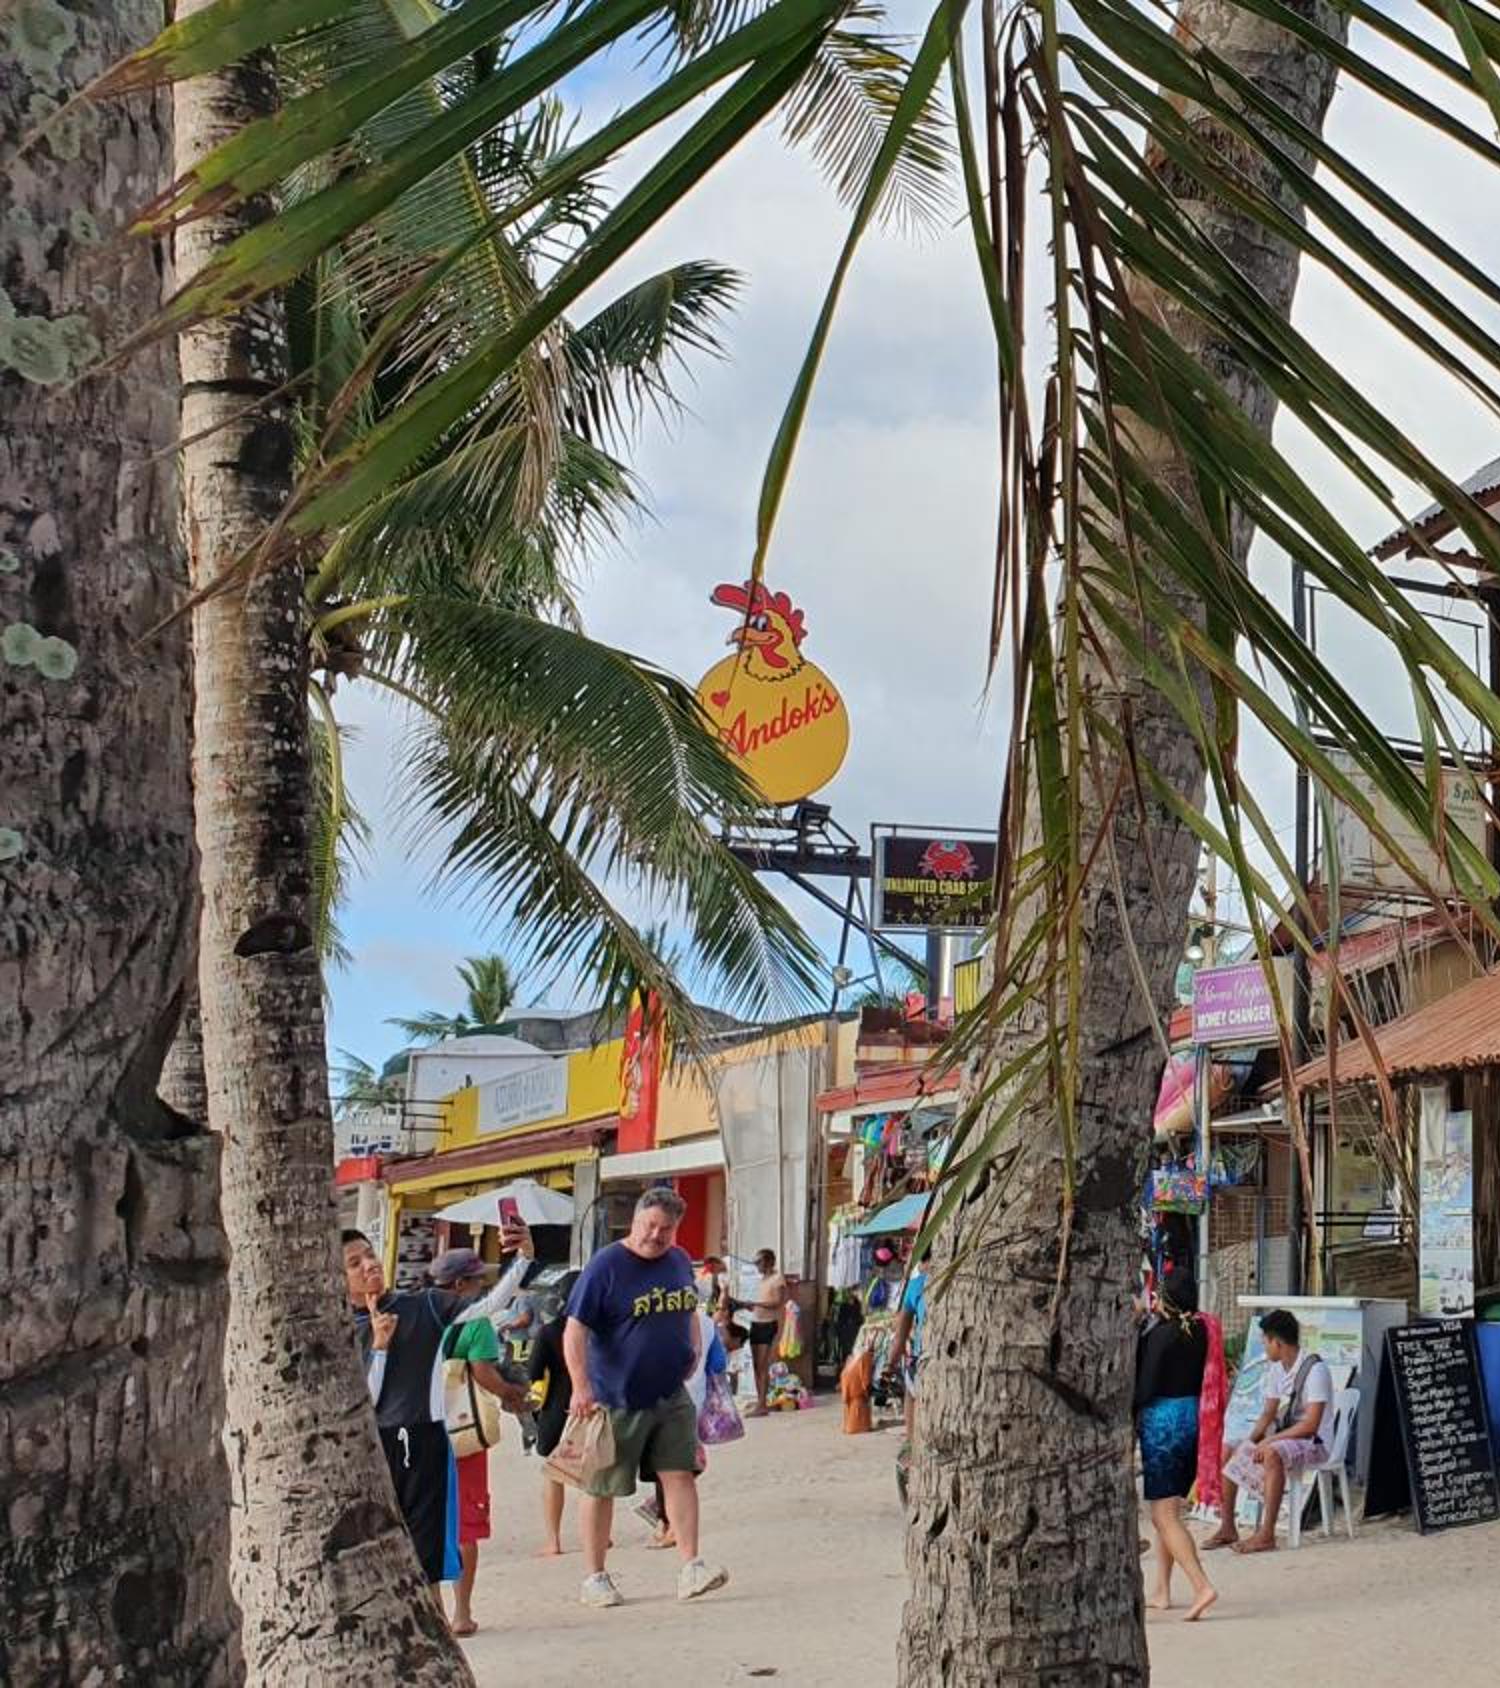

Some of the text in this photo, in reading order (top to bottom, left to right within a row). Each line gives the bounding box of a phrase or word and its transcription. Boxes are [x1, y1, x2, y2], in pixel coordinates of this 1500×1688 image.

[718, 682, 839, 758] Andok's
[940, 880, 967, 896] CRAB
[1197, 1003, 1271, 1029] MONEY CHANGER
[1441, 1320, 1462, 1333] VISA
